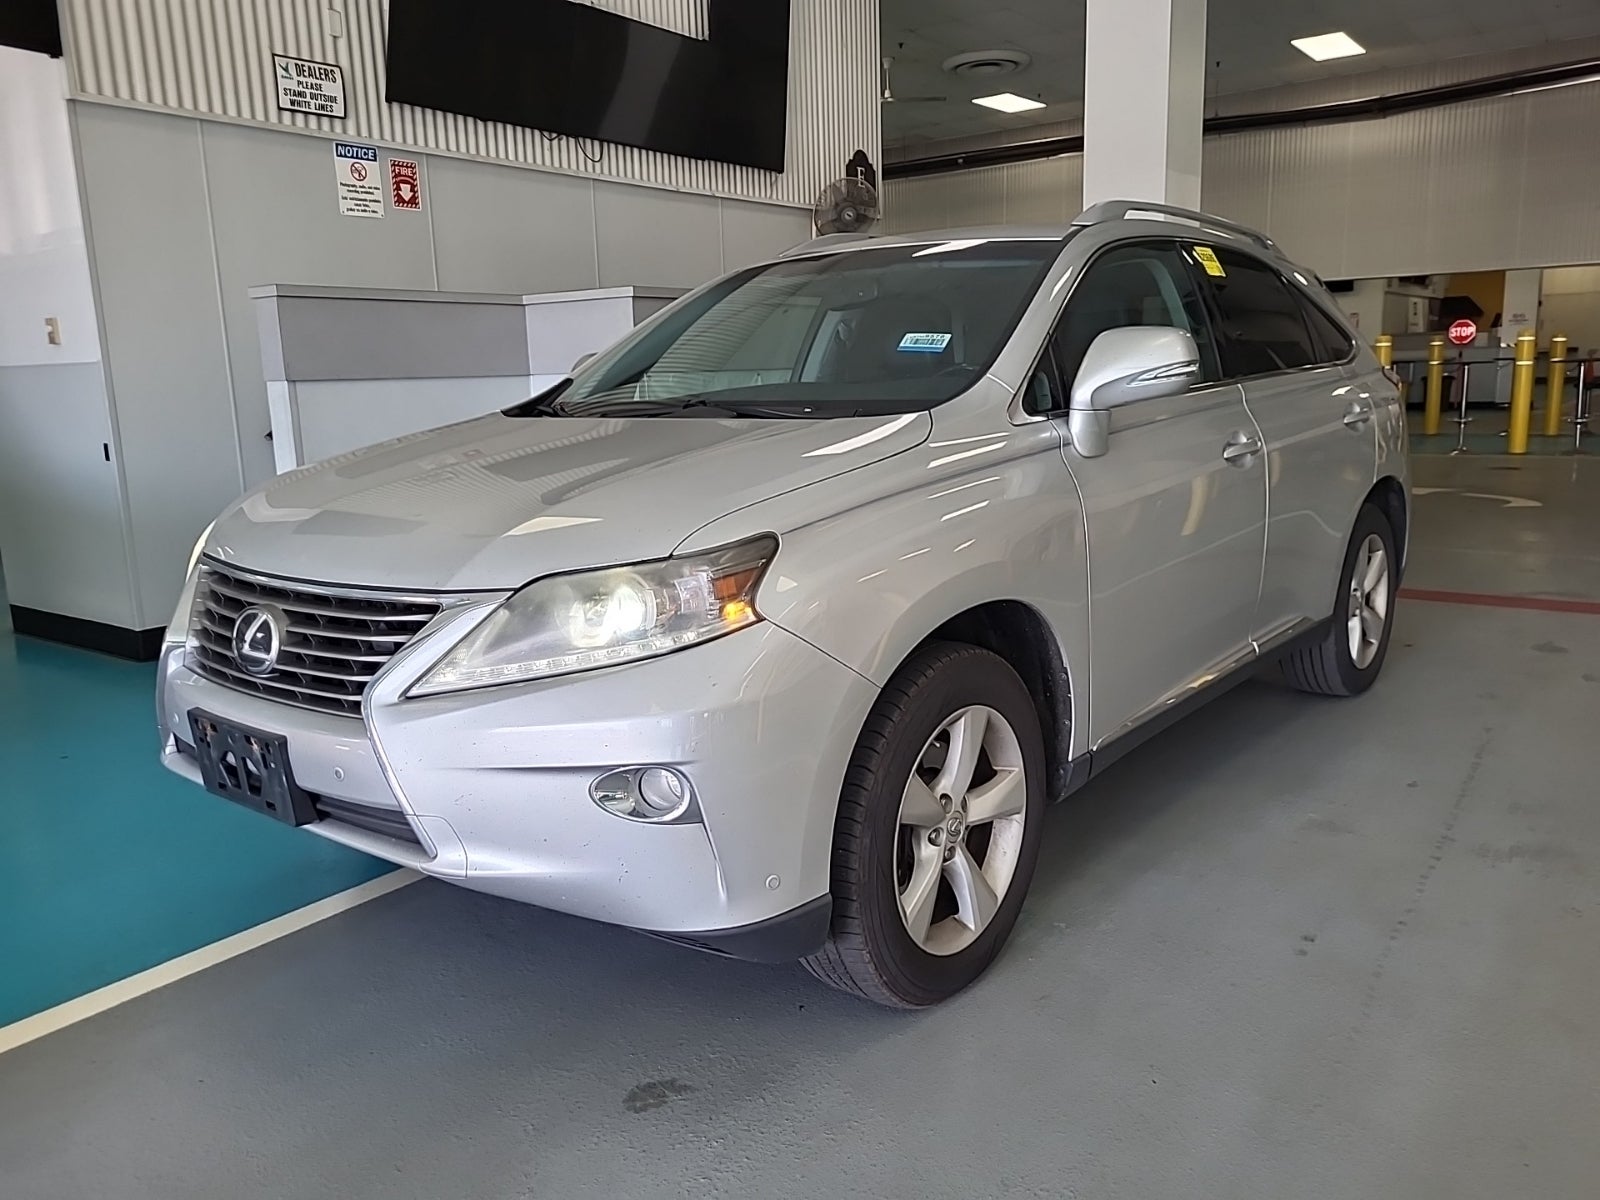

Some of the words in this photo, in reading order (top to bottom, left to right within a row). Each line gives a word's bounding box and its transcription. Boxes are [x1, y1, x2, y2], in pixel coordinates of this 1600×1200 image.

[294, 62, 337, 84] DEALERS
[297, 80, 323, 92] PLEASE
[283, 87, 307, 99] STAND
[309, 91, 339, 105] OUTSIDE
[289, 98, 311, 110] WHITE
[314, 102, 334, 113] LINES
[337, 145, 375, 160] NOTICE
[395, 166, 414, 177] FIRE
[1450, 326, 1476, 337] STOP
